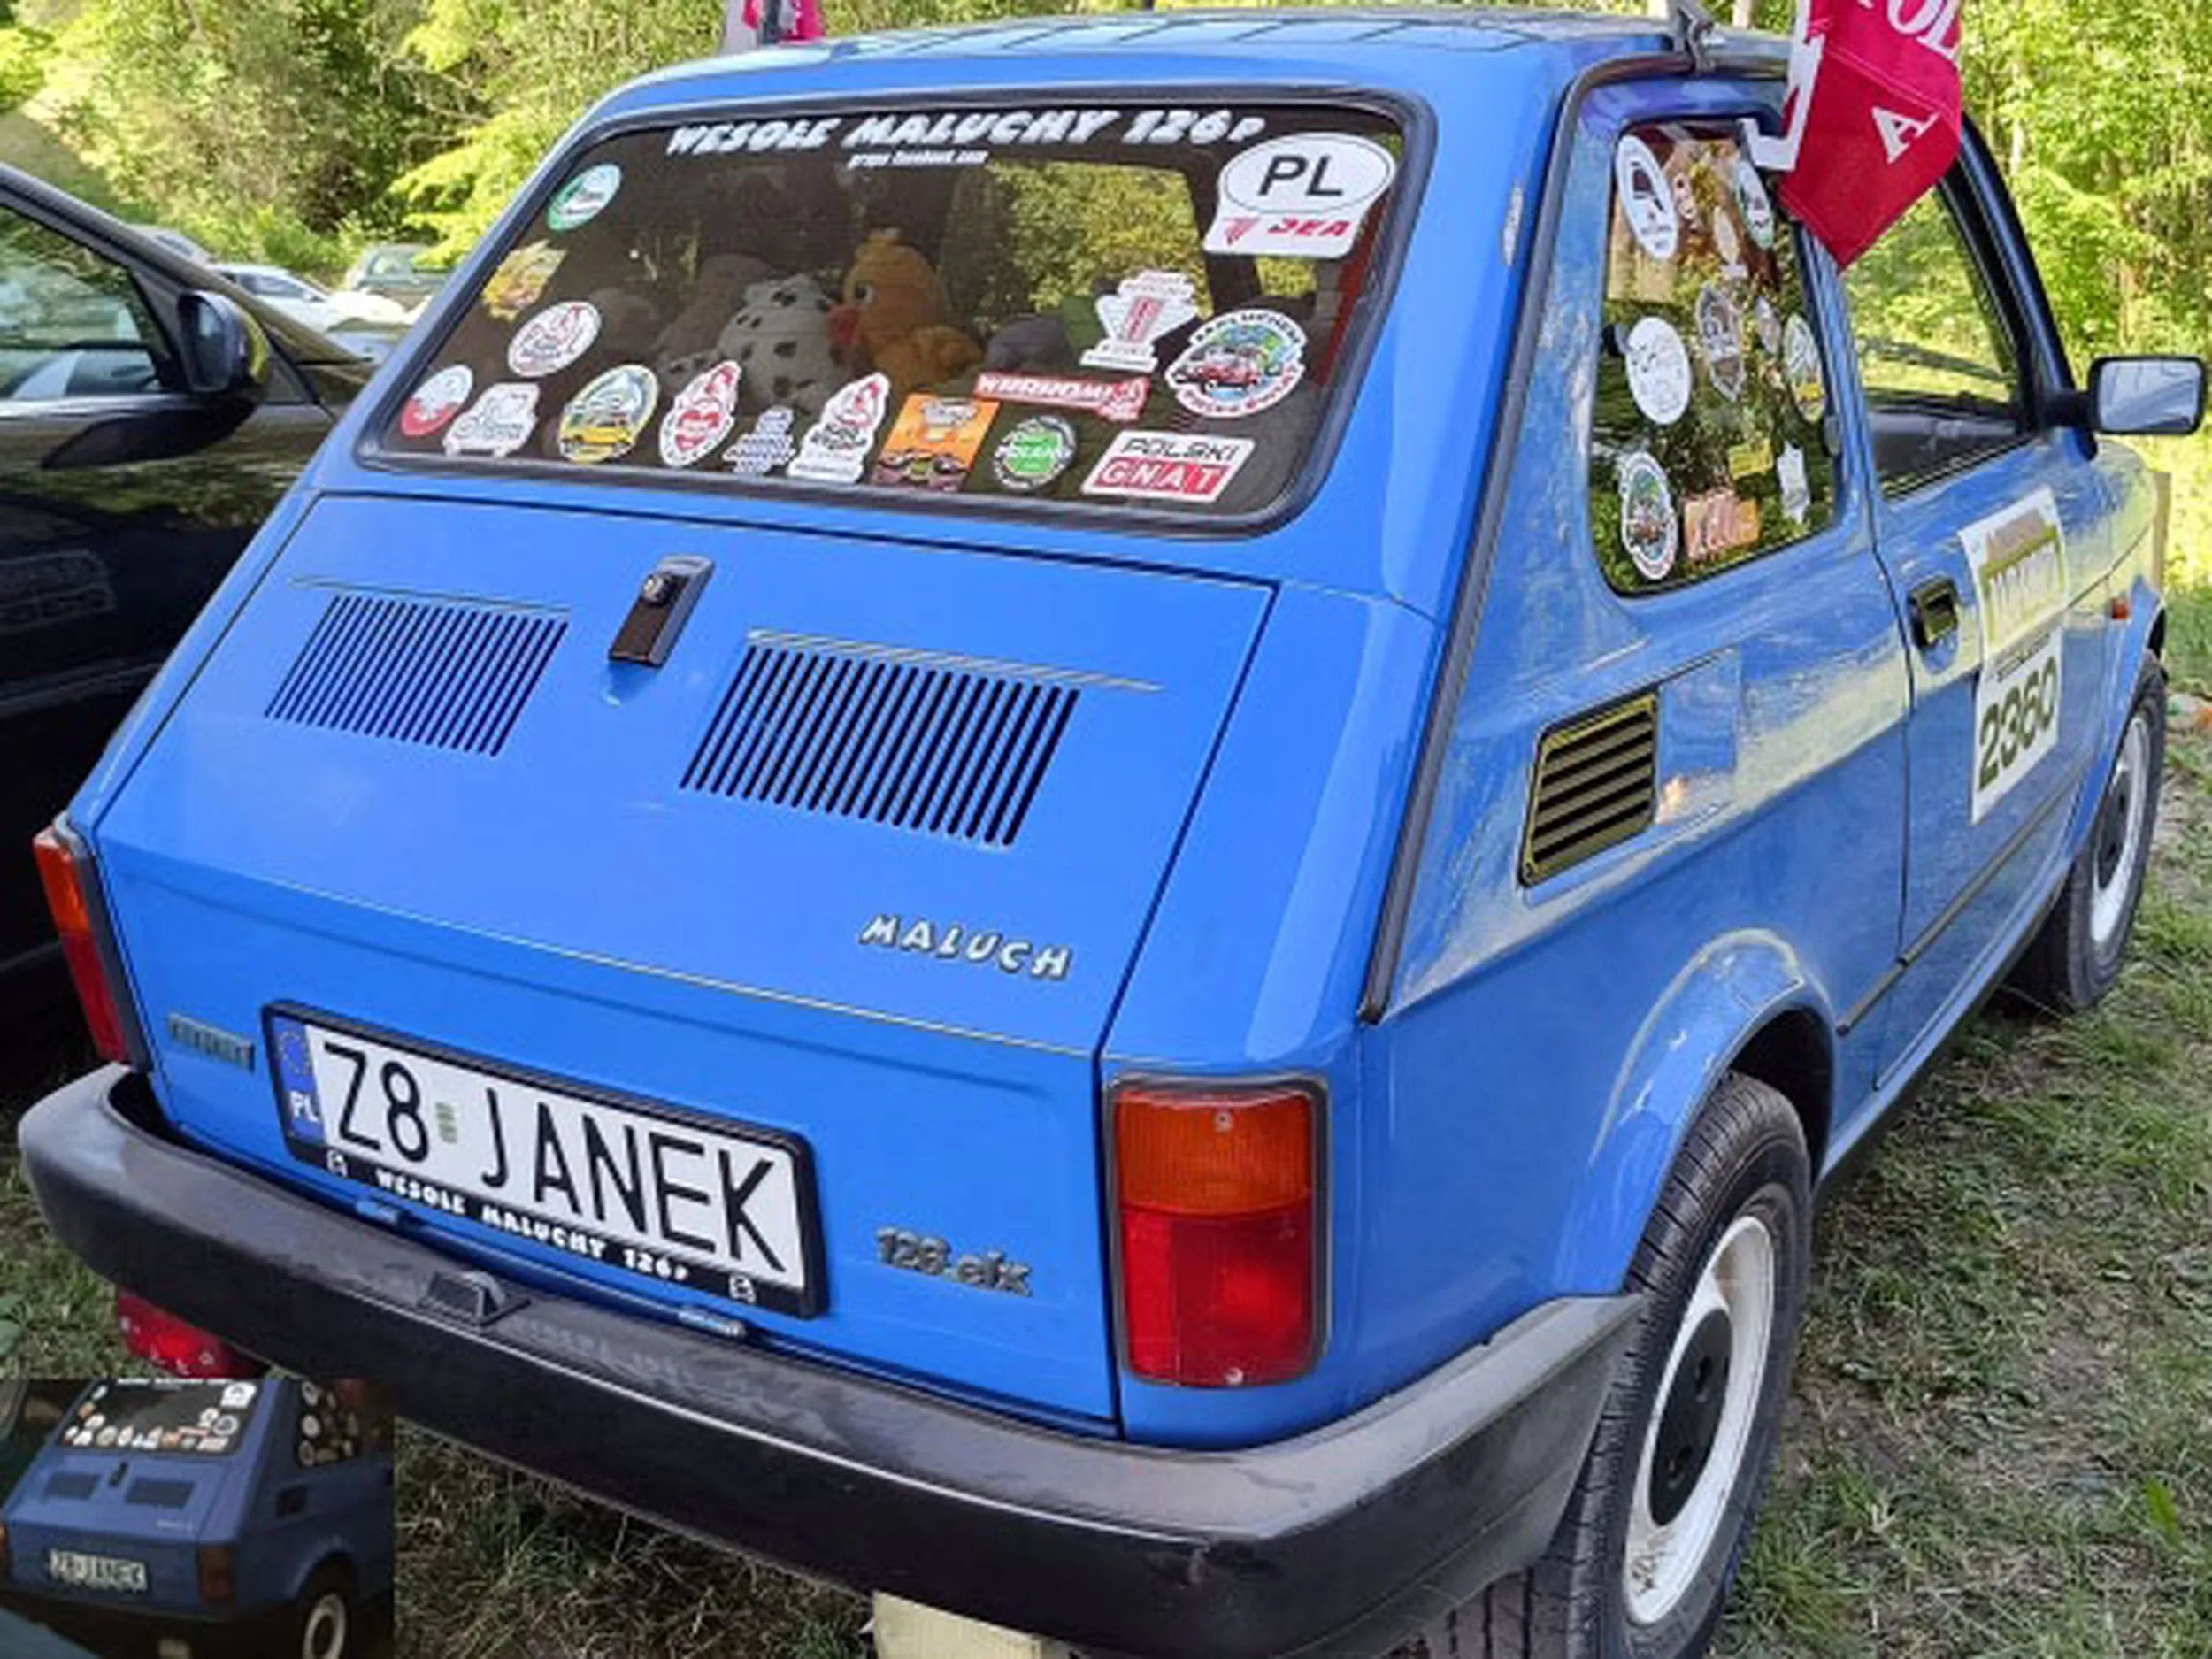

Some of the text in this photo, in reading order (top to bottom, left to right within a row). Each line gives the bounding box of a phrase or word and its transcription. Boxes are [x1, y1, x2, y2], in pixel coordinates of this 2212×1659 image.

[841, 109, 1119, 148] MALUCHY
[1257, 155, 1344, 196] PL
[1122, 438, 1240, 461] POLSKI
[1101, 461, 1220, 493] GNAT
[857, 914, 1072, 979] MALUCH
[289, 1090, 319, 1123] PL
[323, 1041, 430, 1162] Z8
[481, 1087, 787, 1272] JANEK
[481, 1204, 607, 1258] MALUCHY
